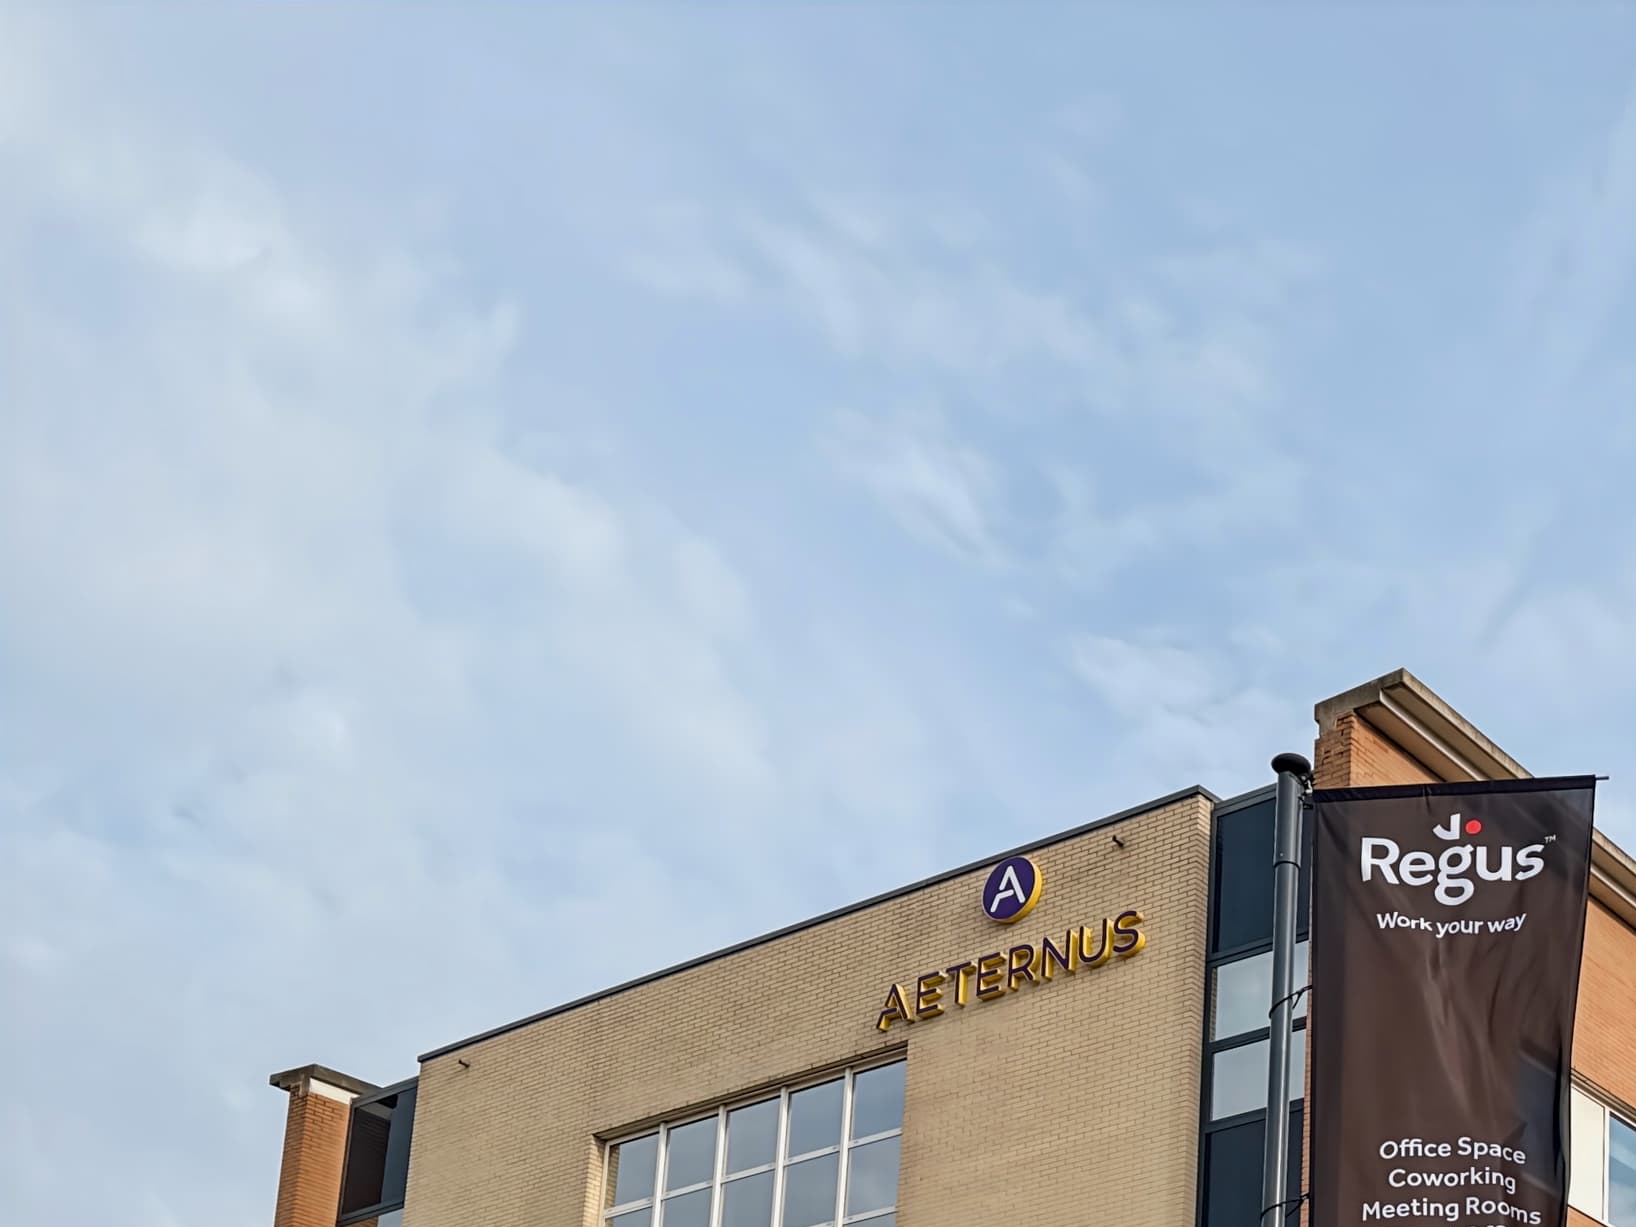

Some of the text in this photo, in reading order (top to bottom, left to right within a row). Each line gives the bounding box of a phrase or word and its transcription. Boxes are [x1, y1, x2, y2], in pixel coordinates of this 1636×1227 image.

[1361, 836, 1545, 906] Regus
[1376, 911, 1527, 938] Work your way
[876, 910, 1146, 1033] AETERNUS
[1379, 1136, 1527, 1165] Office Space
[1388, 1166, 1516, 1195] Coworking
[1362, 1197, 1542, 1225] Meeting Rooms
